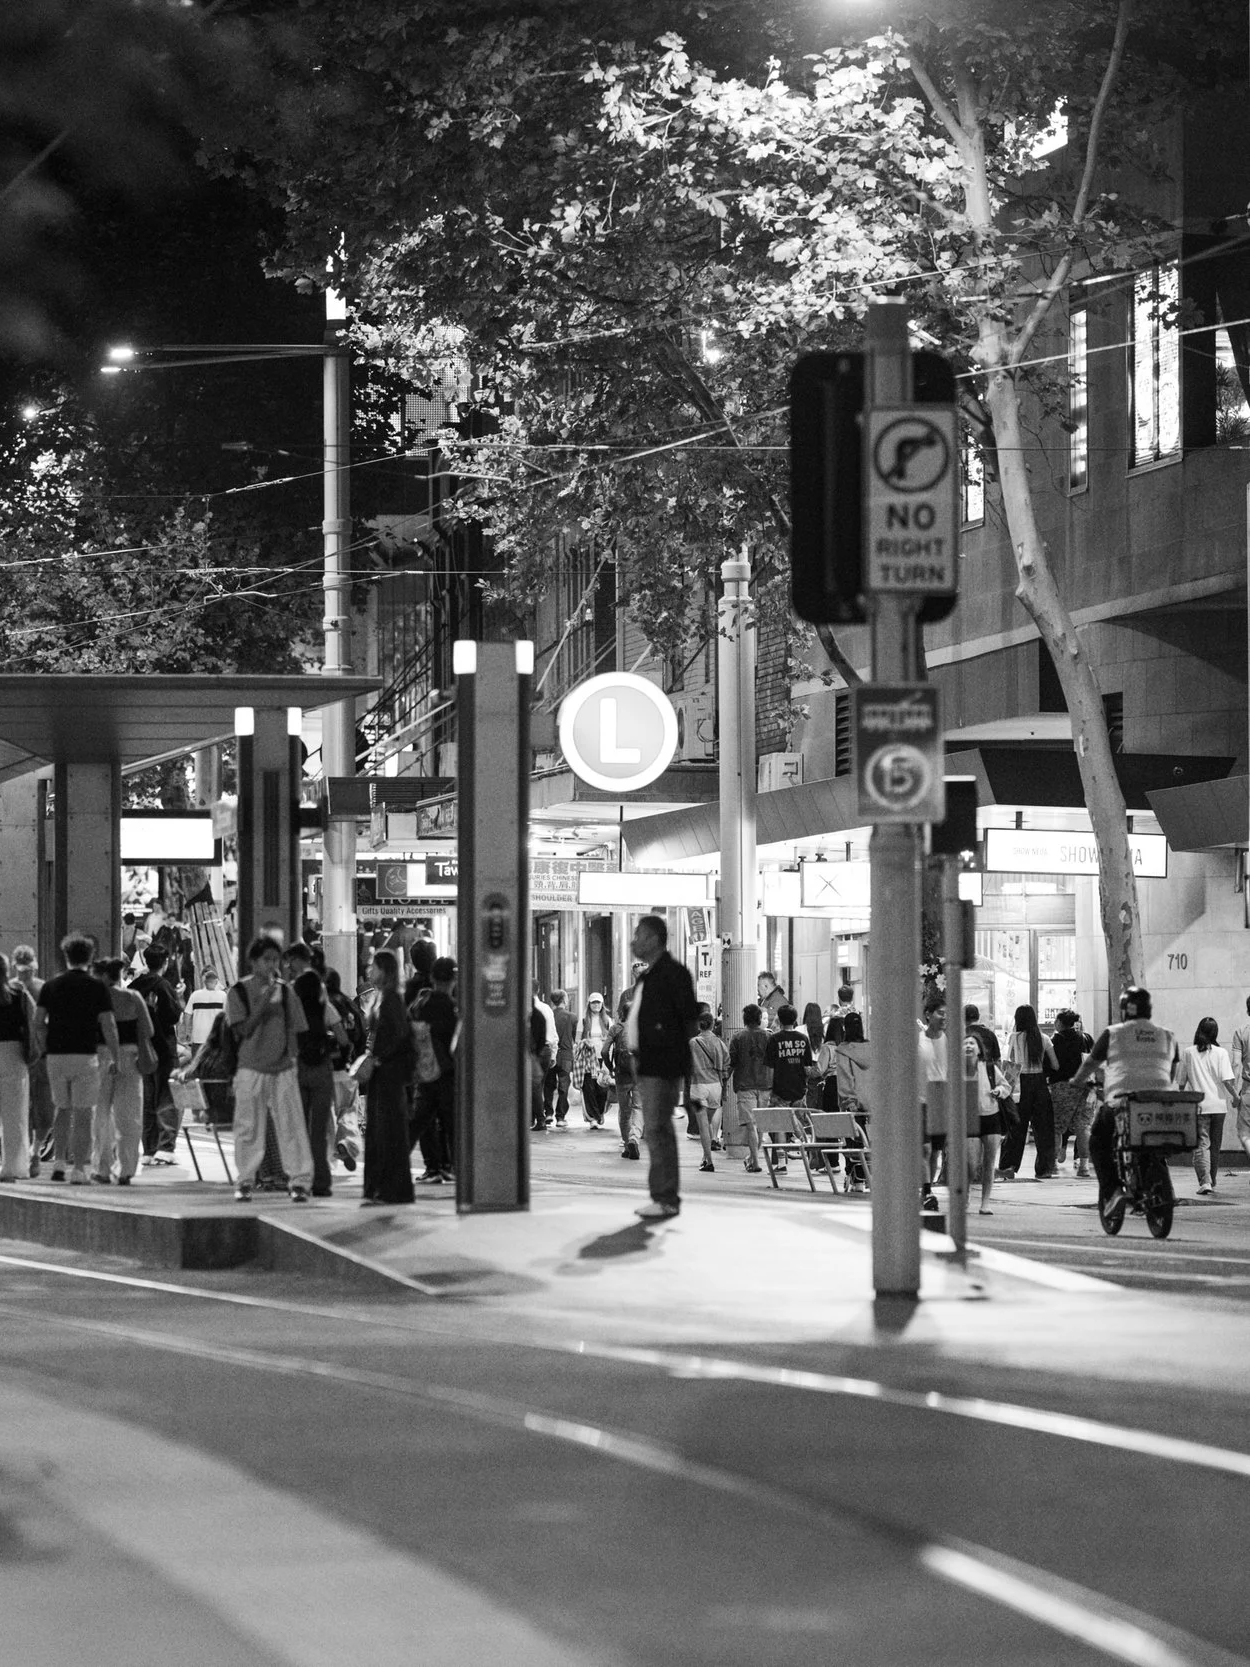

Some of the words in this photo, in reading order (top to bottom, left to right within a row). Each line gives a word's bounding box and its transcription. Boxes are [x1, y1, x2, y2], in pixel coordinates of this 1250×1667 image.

[886, 503, 936, 531] NO
[876, 537, 945, 558] RIGHT
[880, 564, 945, 583] TURN
[600, 698, 641, 764] L
[532, 894, 572, 902] SHOULDER
[362, 907, 379, 915] Gifts
[380, 907, 404, 916] Quality
[406, 907, 446, 915] Accessories
[1168, 953, 1188, 970] 710
[778, 1040, 793, 1050] I'M
[794, 1040, 807, 1048] SO
[778, 1048, 806, 1058] HAPPY
